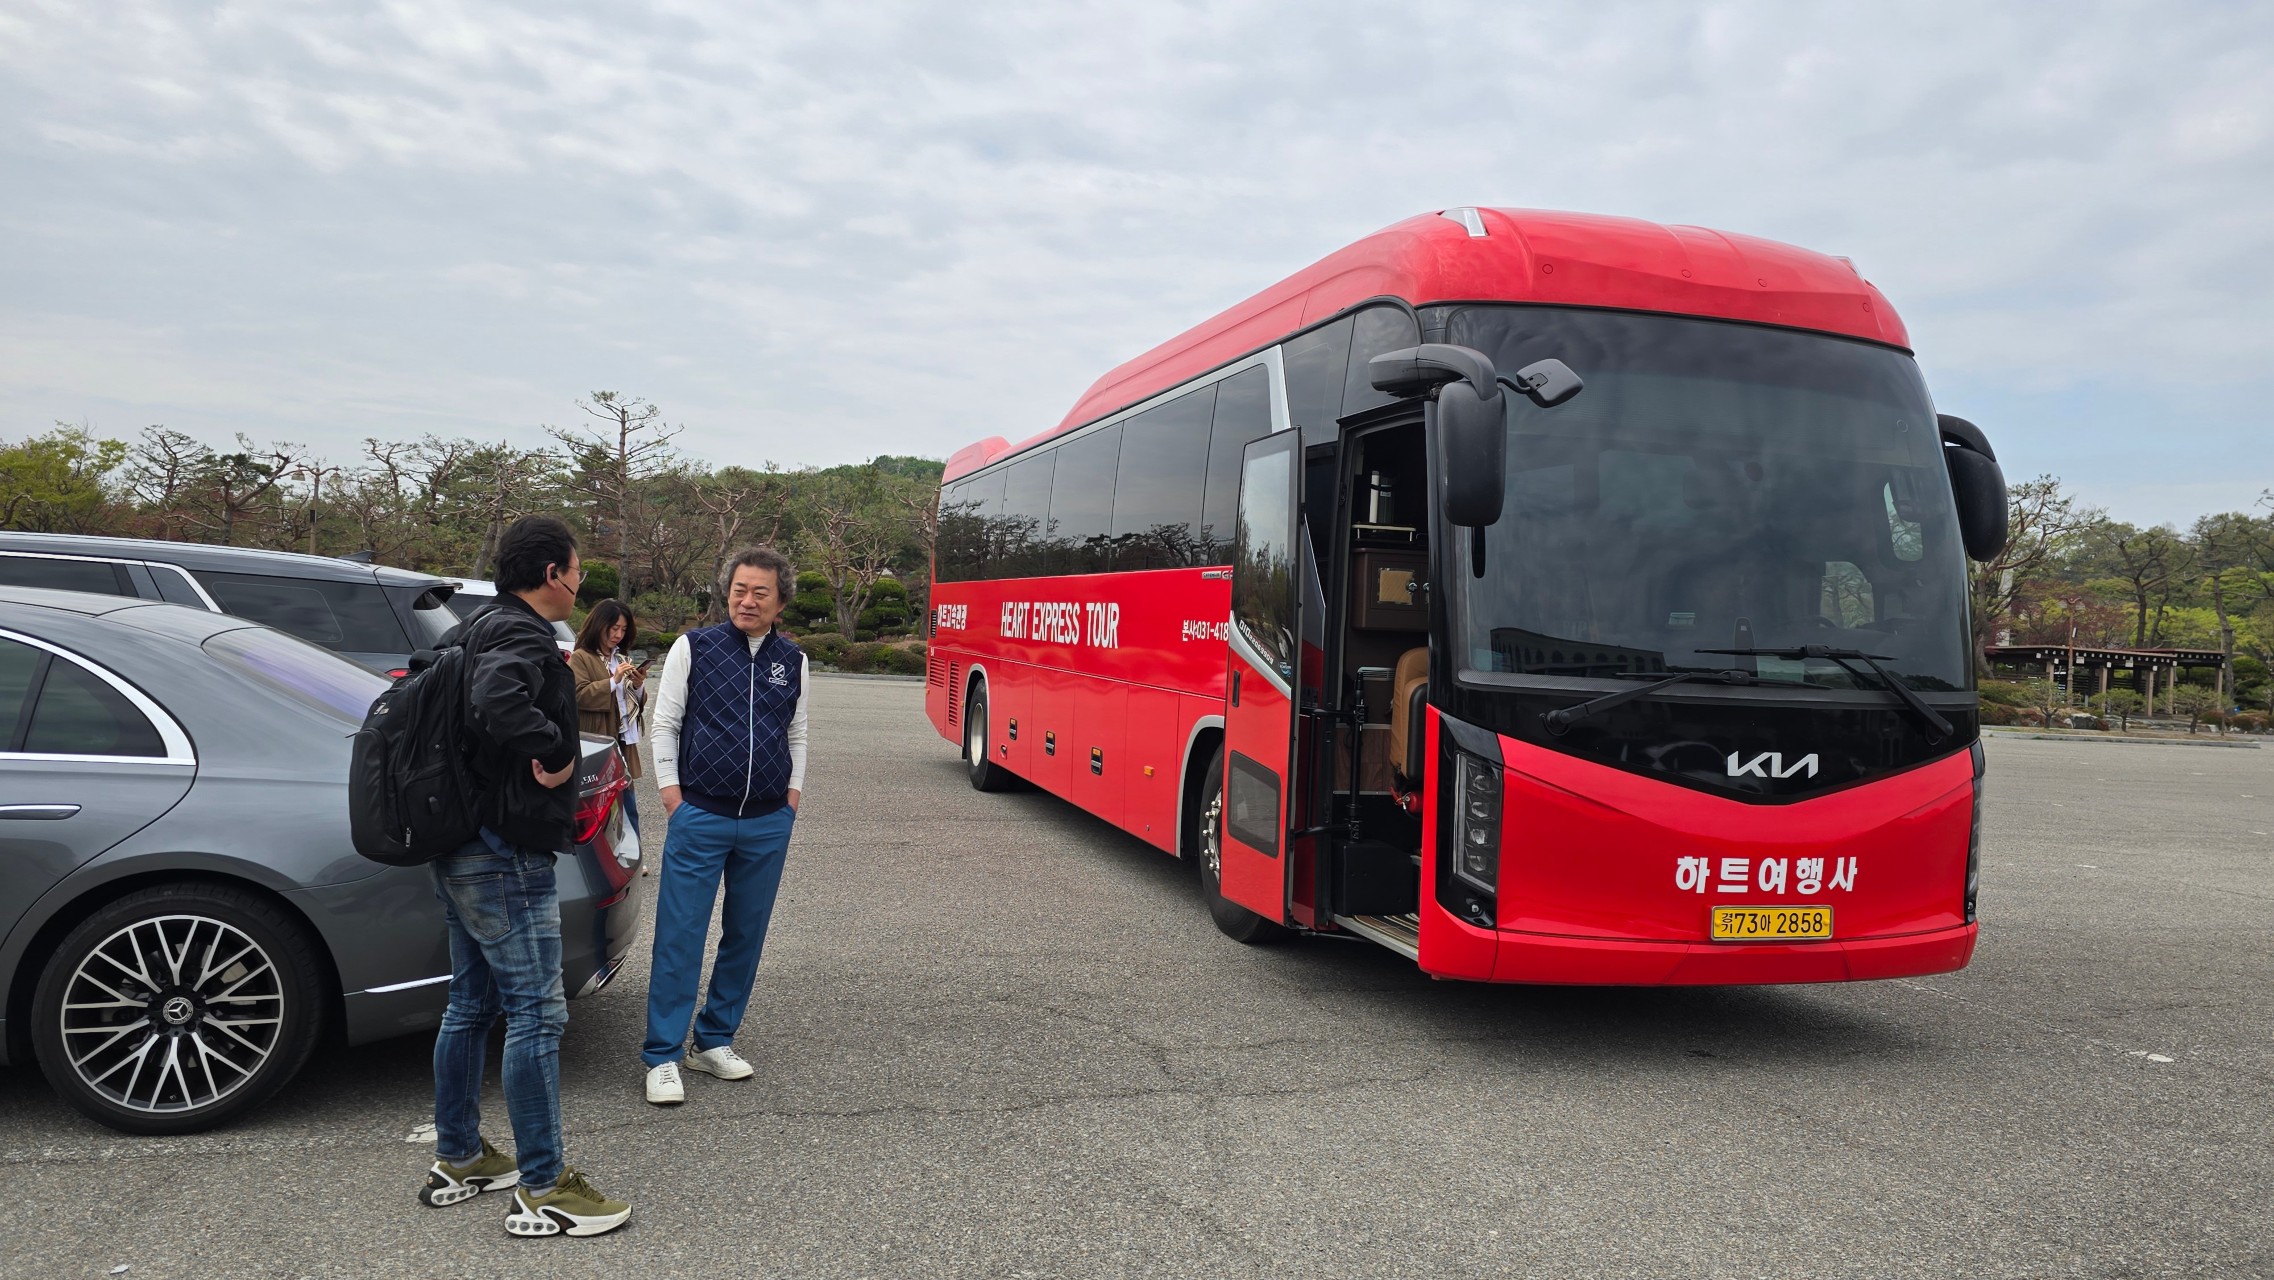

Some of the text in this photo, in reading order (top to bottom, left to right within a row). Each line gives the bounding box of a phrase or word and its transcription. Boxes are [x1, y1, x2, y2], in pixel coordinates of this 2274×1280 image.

[1000, 602, 1119, 649] HEART EXPRESS TOUR
[1727, 750, 1818, 778] KIA
[1675, 856, 1857, 893] 하트여행사
[1776, 912, 1823, 934] 2858
